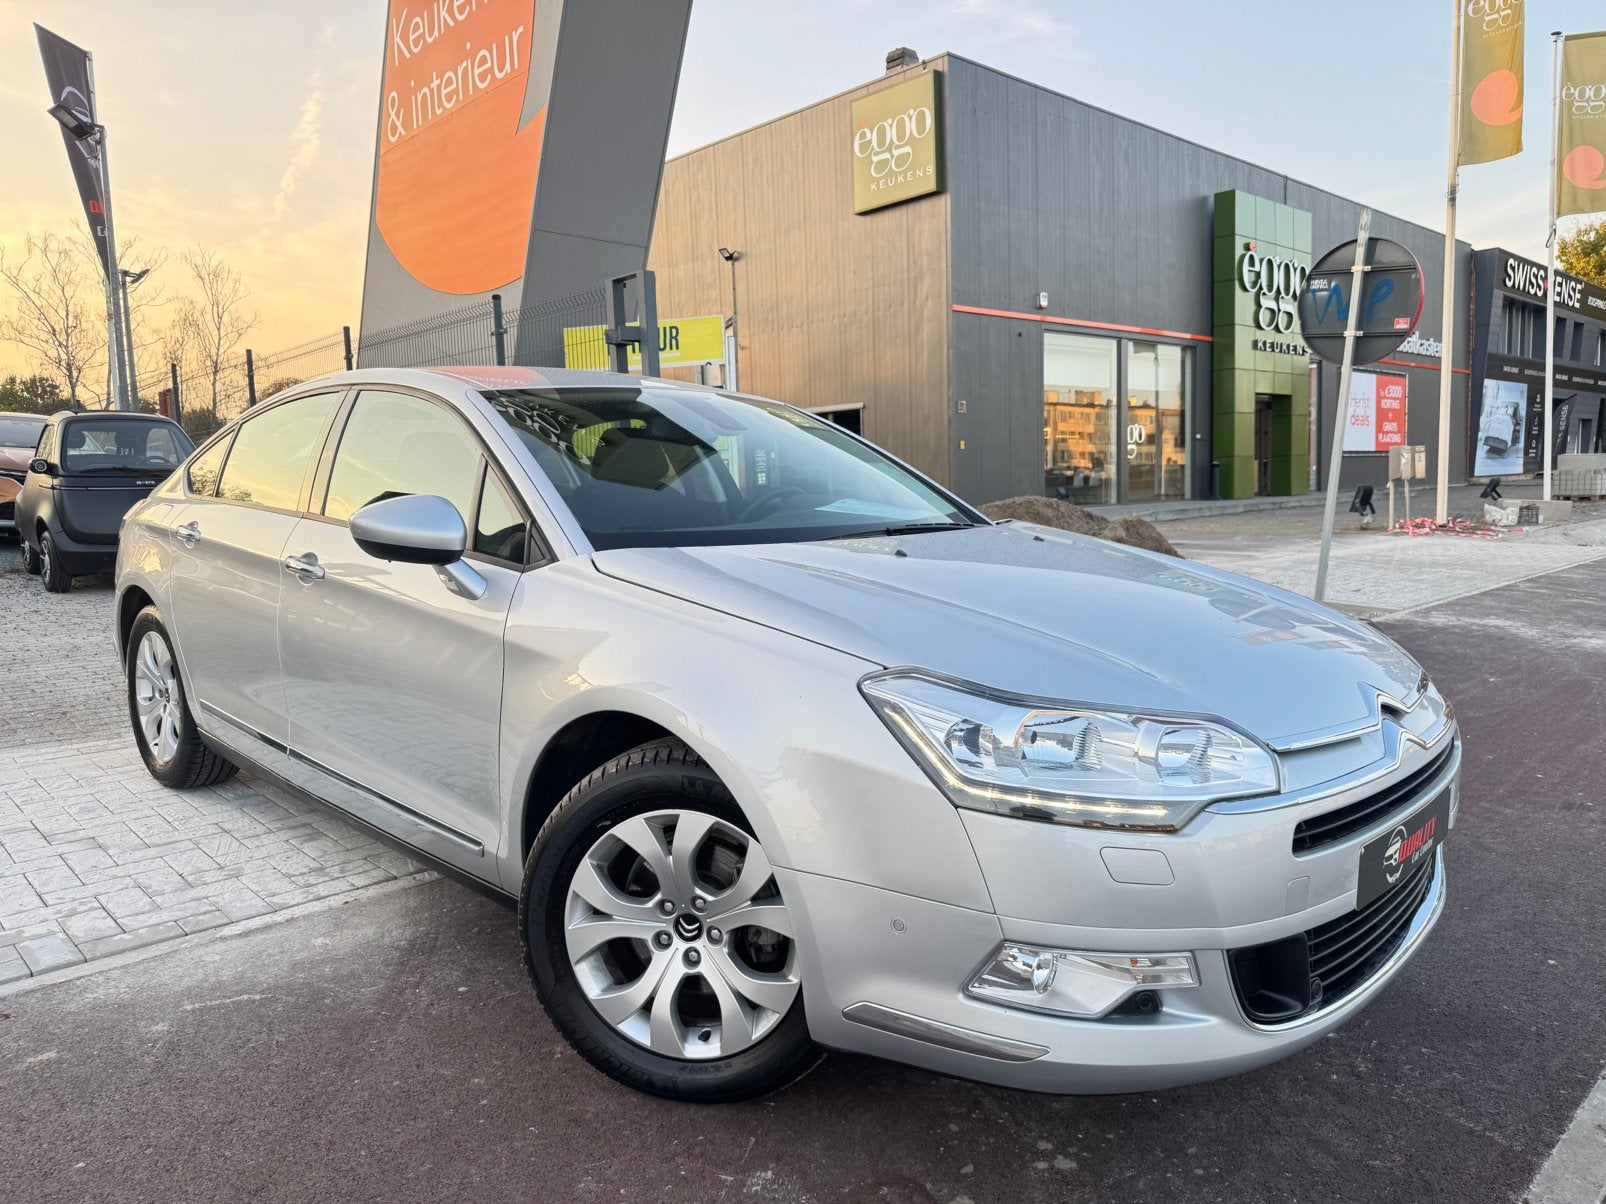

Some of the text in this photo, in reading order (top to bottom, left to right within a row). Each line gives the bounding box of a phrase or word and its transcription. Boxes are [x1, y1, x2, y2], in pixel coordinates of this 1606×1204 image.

[387, 25, 524, 143] & interieur
[870, 165, 934, 192] KEUKENS
[1505, 257, 1582, 309] SWISS ENSE
[1256, 338, 1312, 356] KEUKENS
[1350, 408, 1371, 427] deals
[1398, 815, 1437, 863] QUALITY
